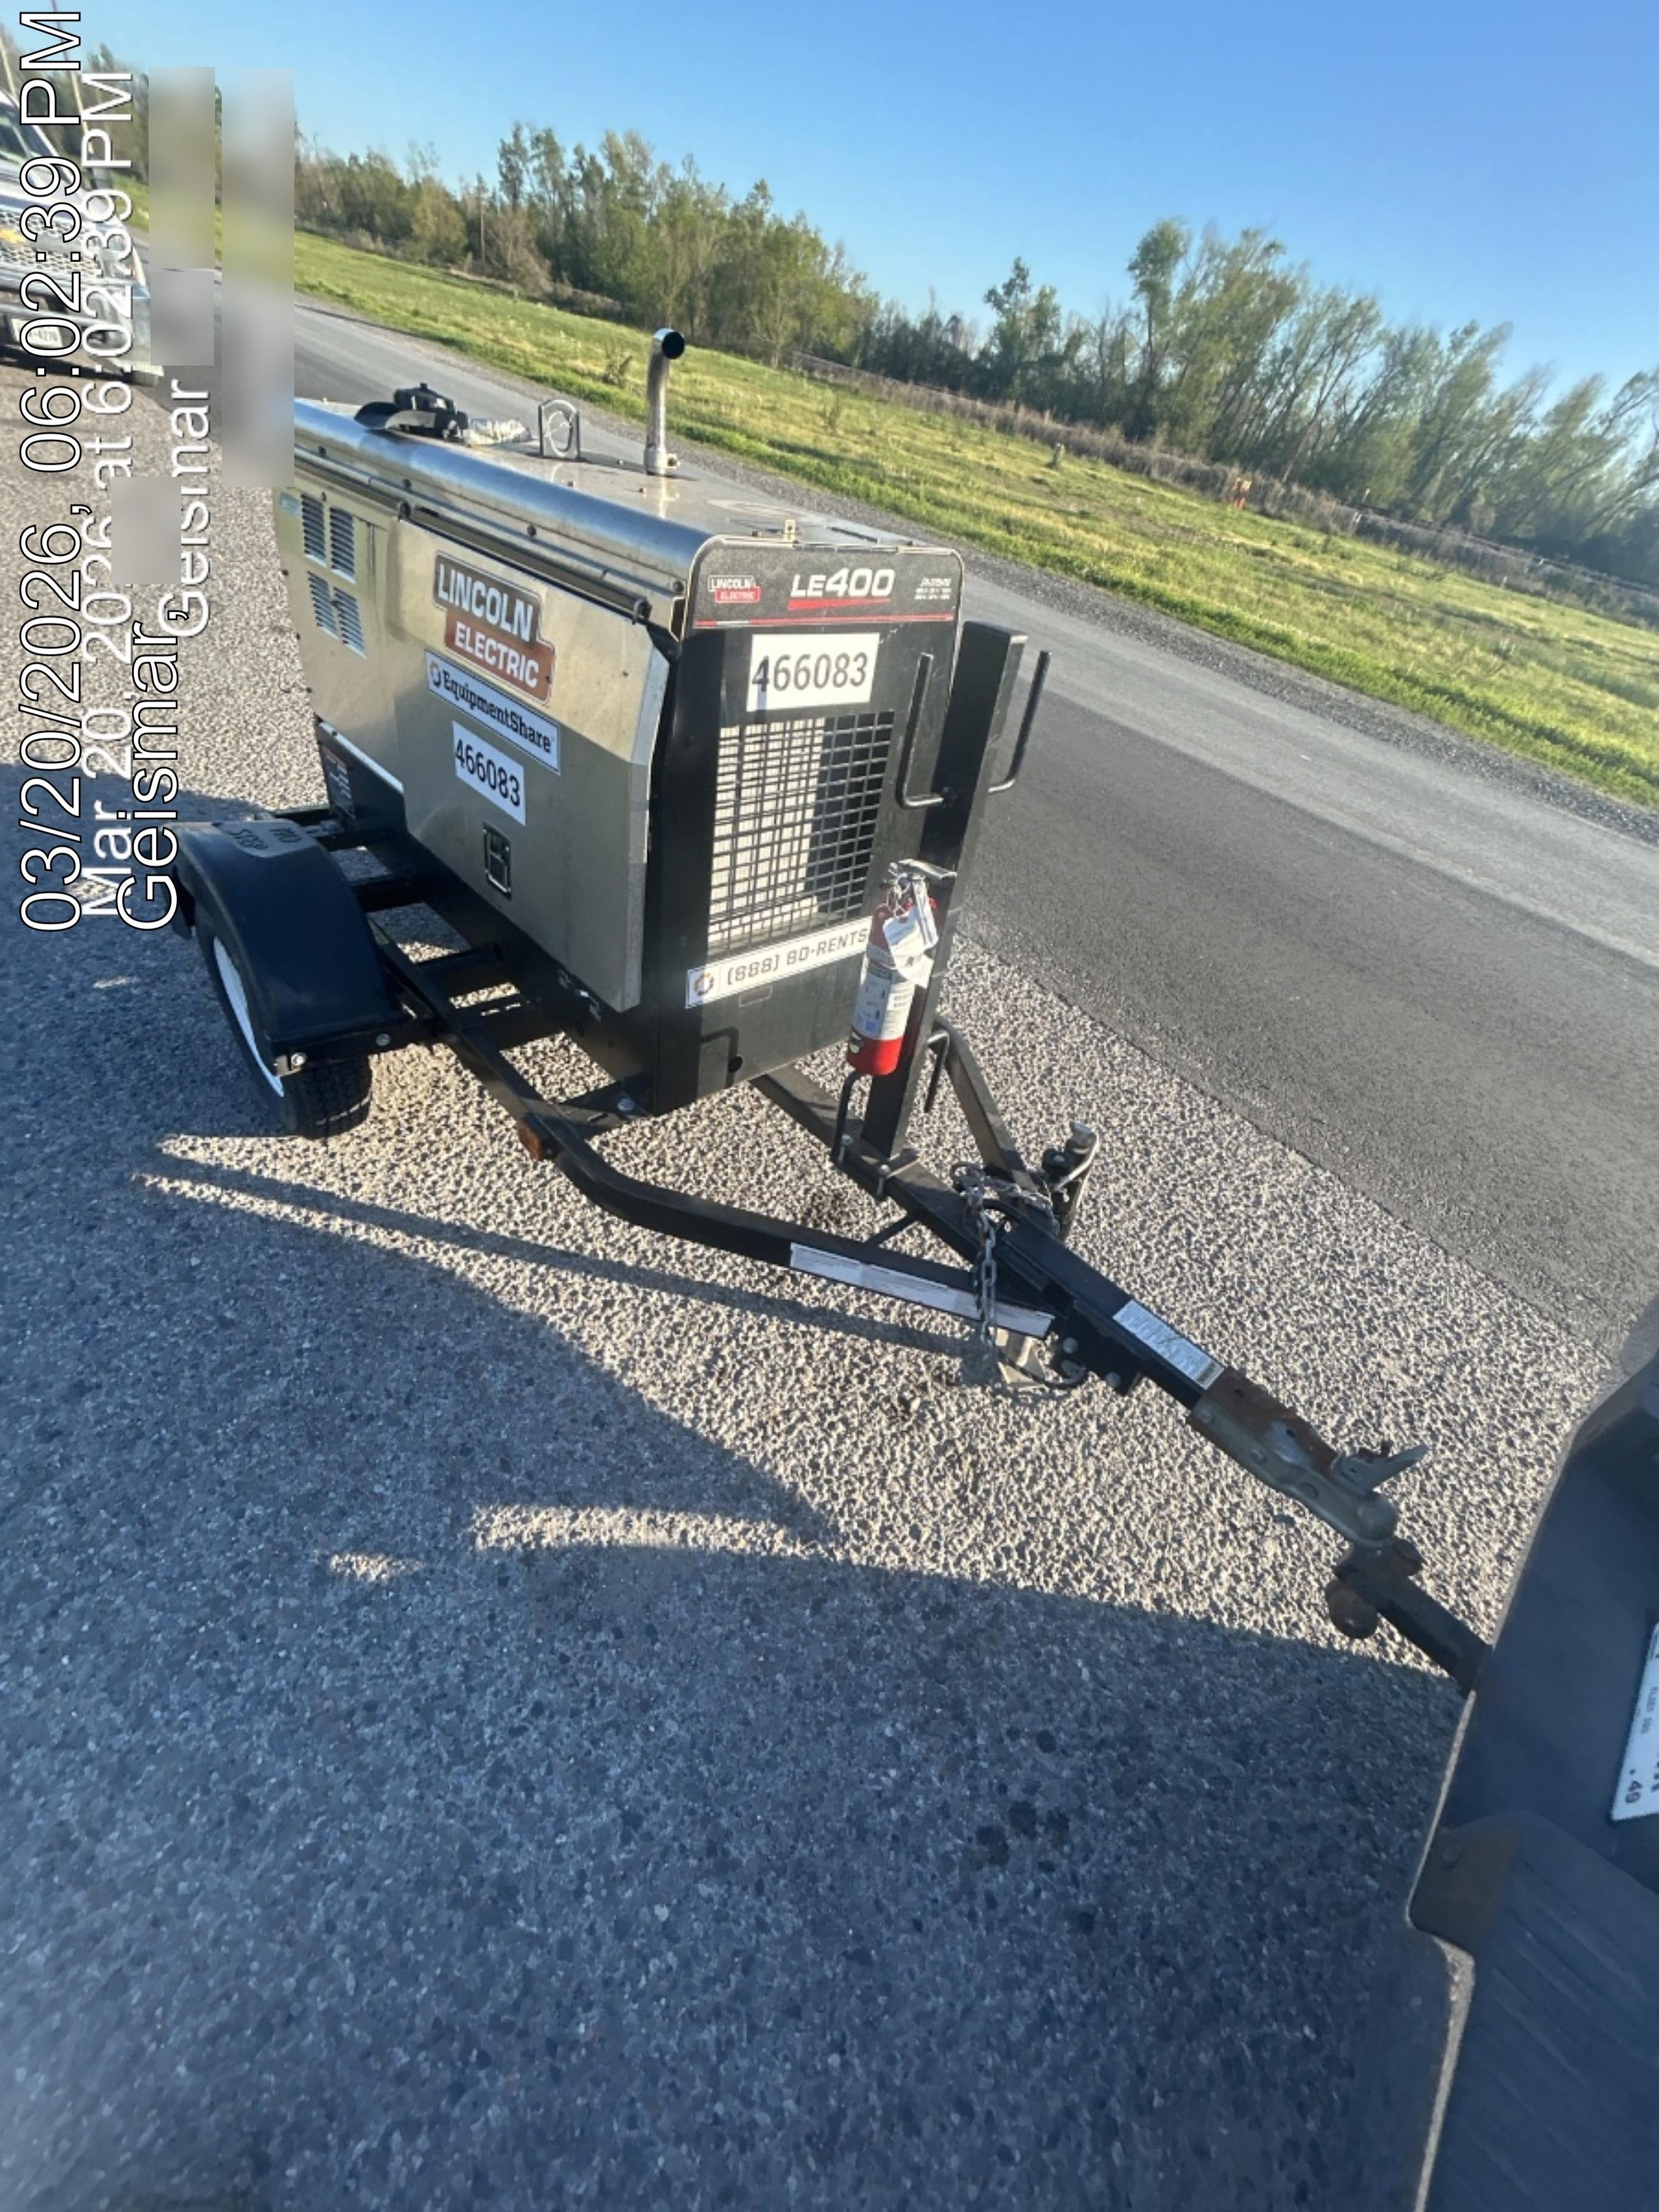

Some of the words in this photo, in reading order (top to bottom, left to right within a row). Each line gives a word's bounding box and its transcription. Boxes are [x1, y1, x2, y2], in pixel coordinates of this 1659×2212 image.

[438, 563, 533, 642] LINCOLN
[790, 568, 895, 598] LE400
[455, 621, 539, 688] ELECTRIC
[752, 651, 868, 692] 466083
[442, 670, 552, 753] EquipmentShare
[455, 739, 520, 807] 466083
[728, 954, 780, 986] (888)
[786, 928, 868, 966] 80-RENTS
